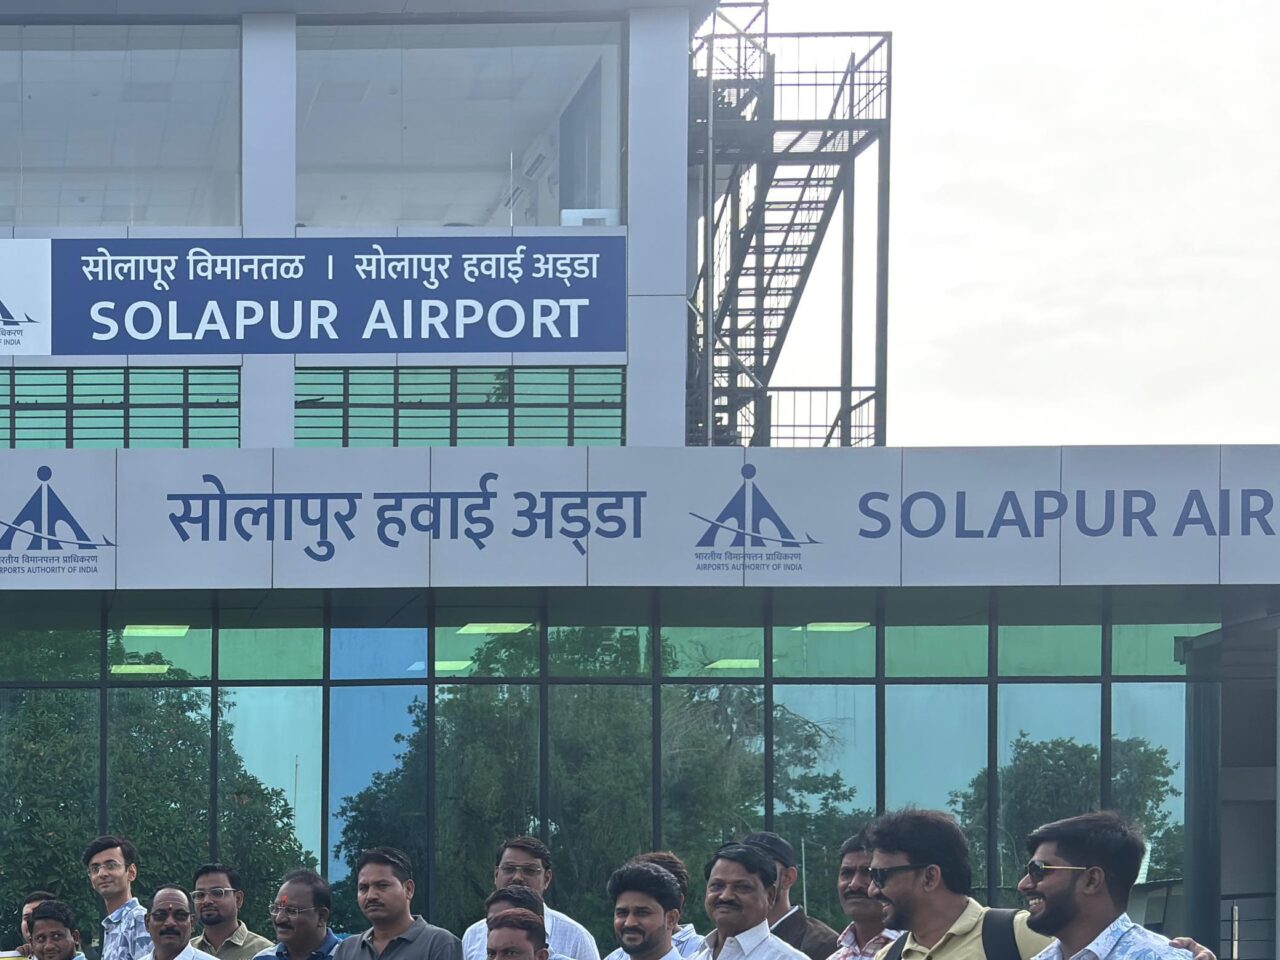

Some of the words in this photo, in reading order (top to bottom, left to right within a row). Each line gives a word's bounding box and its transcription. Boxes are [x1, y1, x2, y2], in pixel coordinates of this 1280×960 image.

[81, 248, 178, 290] सोलापूर
[187, 248, 305, 280] विमानतळ
[355, 244, 452, 289] सोलापुर
[462, 245, 526, 283] हवाई
[91, 300, 338, 340] SOLAPUR
[362, 299, 589, 338] AIRPORT
[167, 474, 362, 562] सोलापुर
[374, 473, 498, 549] हवाई
[858, 490, 1158, 538] SOLAPUR
[1172, 489, 1276, 536] AIR
